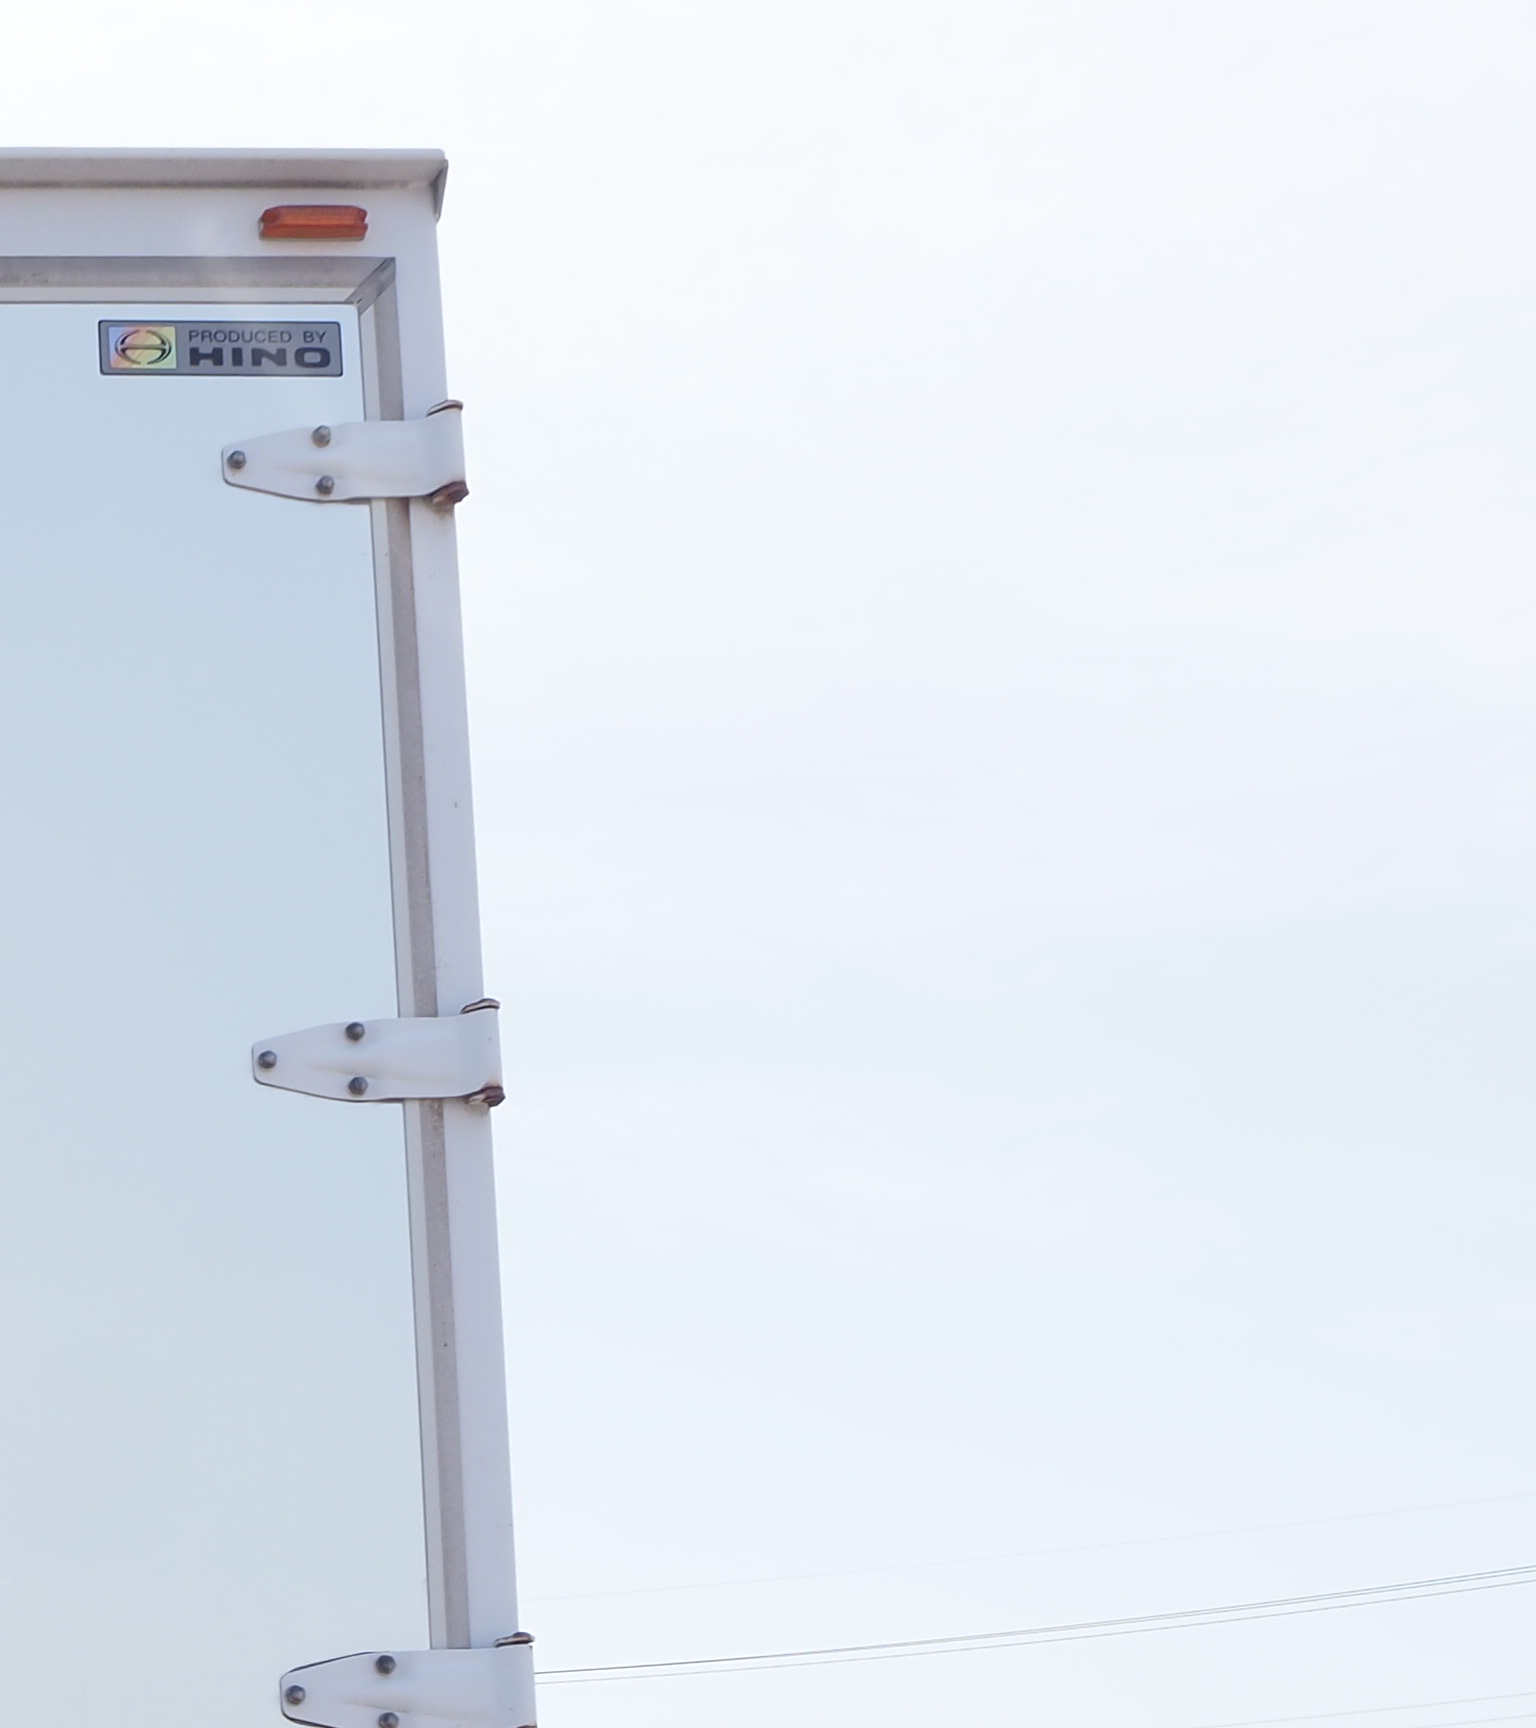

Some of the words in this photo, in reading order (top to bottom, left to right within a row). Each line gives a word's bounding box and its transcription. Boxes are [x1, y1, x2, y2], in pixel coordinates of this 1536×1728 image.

[188, 330, 291, 343] PRODUCED
[303, 331, 326, 343] BY
[188, 346, 331, 369] HINO
